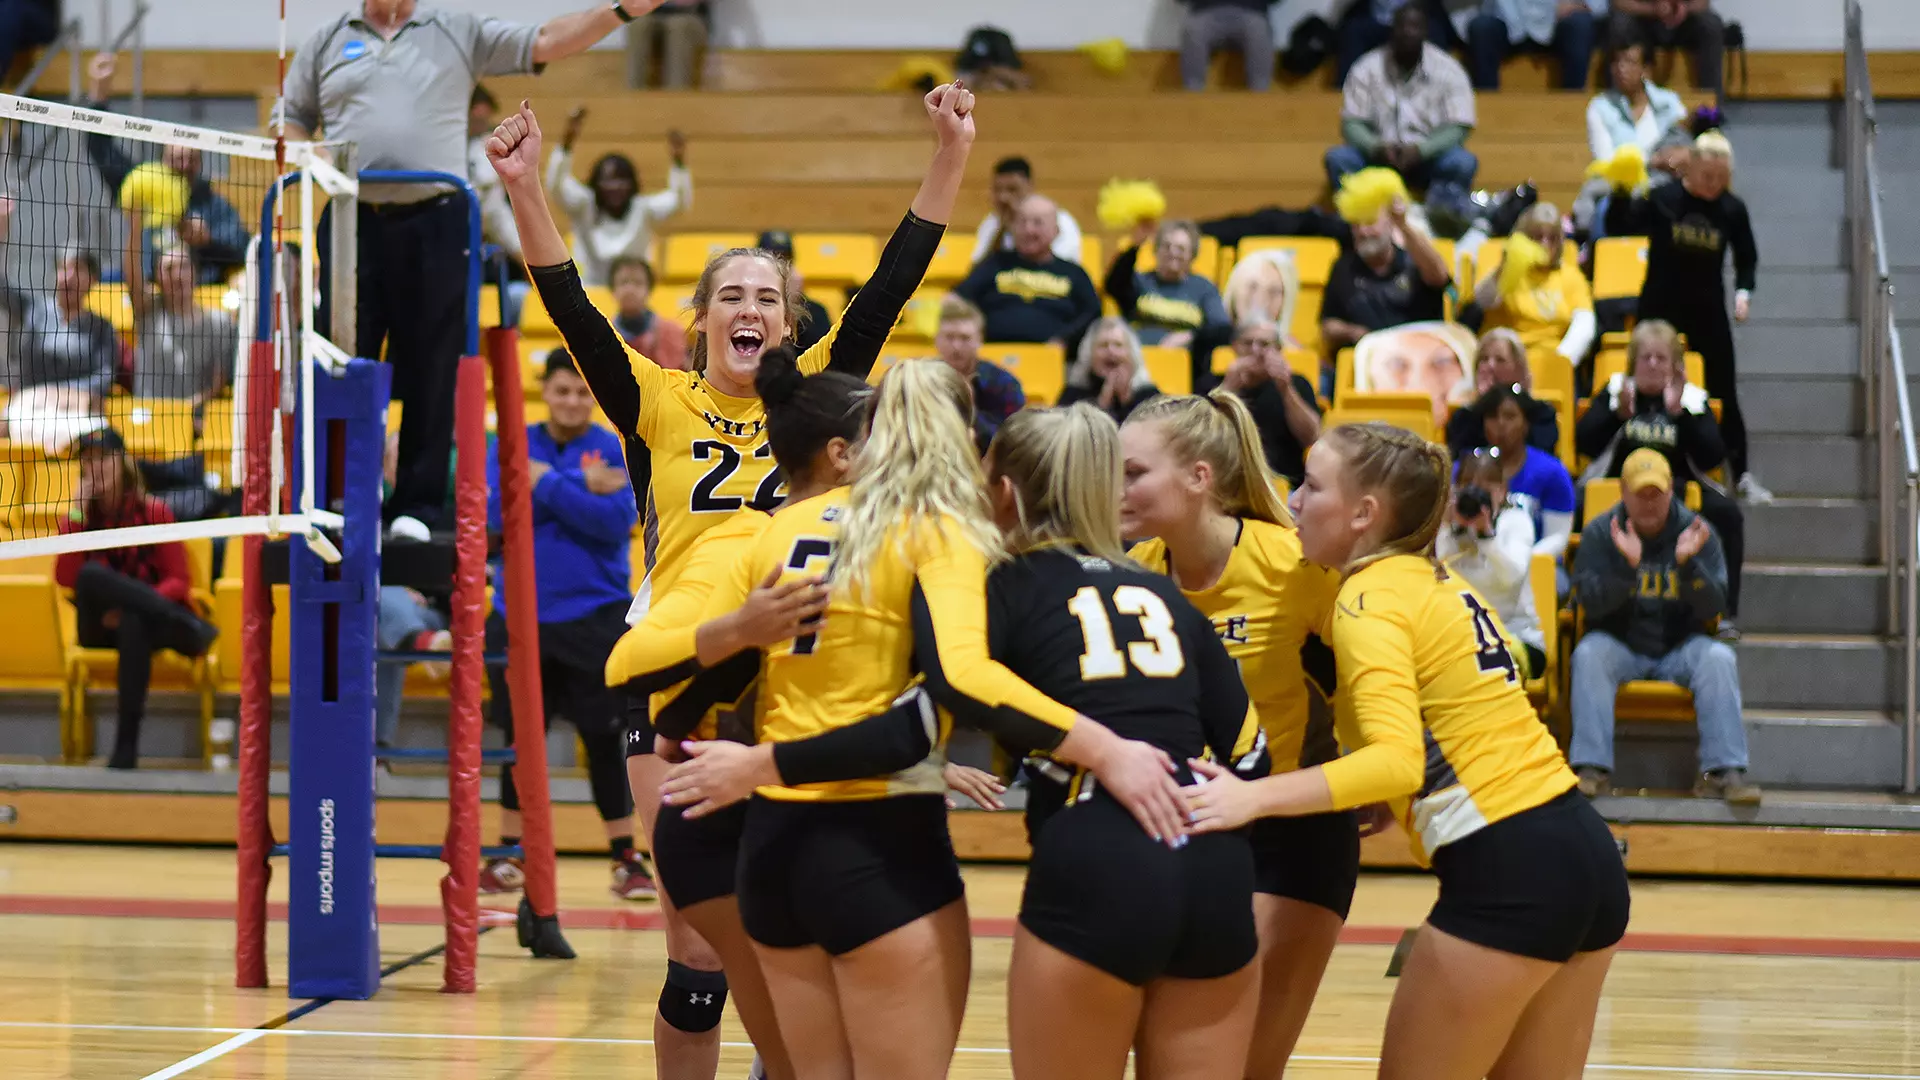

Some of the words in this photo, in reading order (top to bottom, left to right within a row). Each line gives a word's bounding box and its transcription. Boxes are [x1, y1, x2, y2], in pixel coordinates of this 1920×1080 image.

[690, 438, 789, 514] 22
[1067, 584, 1187, 682] 13
[1459, 590, 1518, 684] 4
[318, 798, 337, 850] sports
[317, 851, 336, 914] imports
